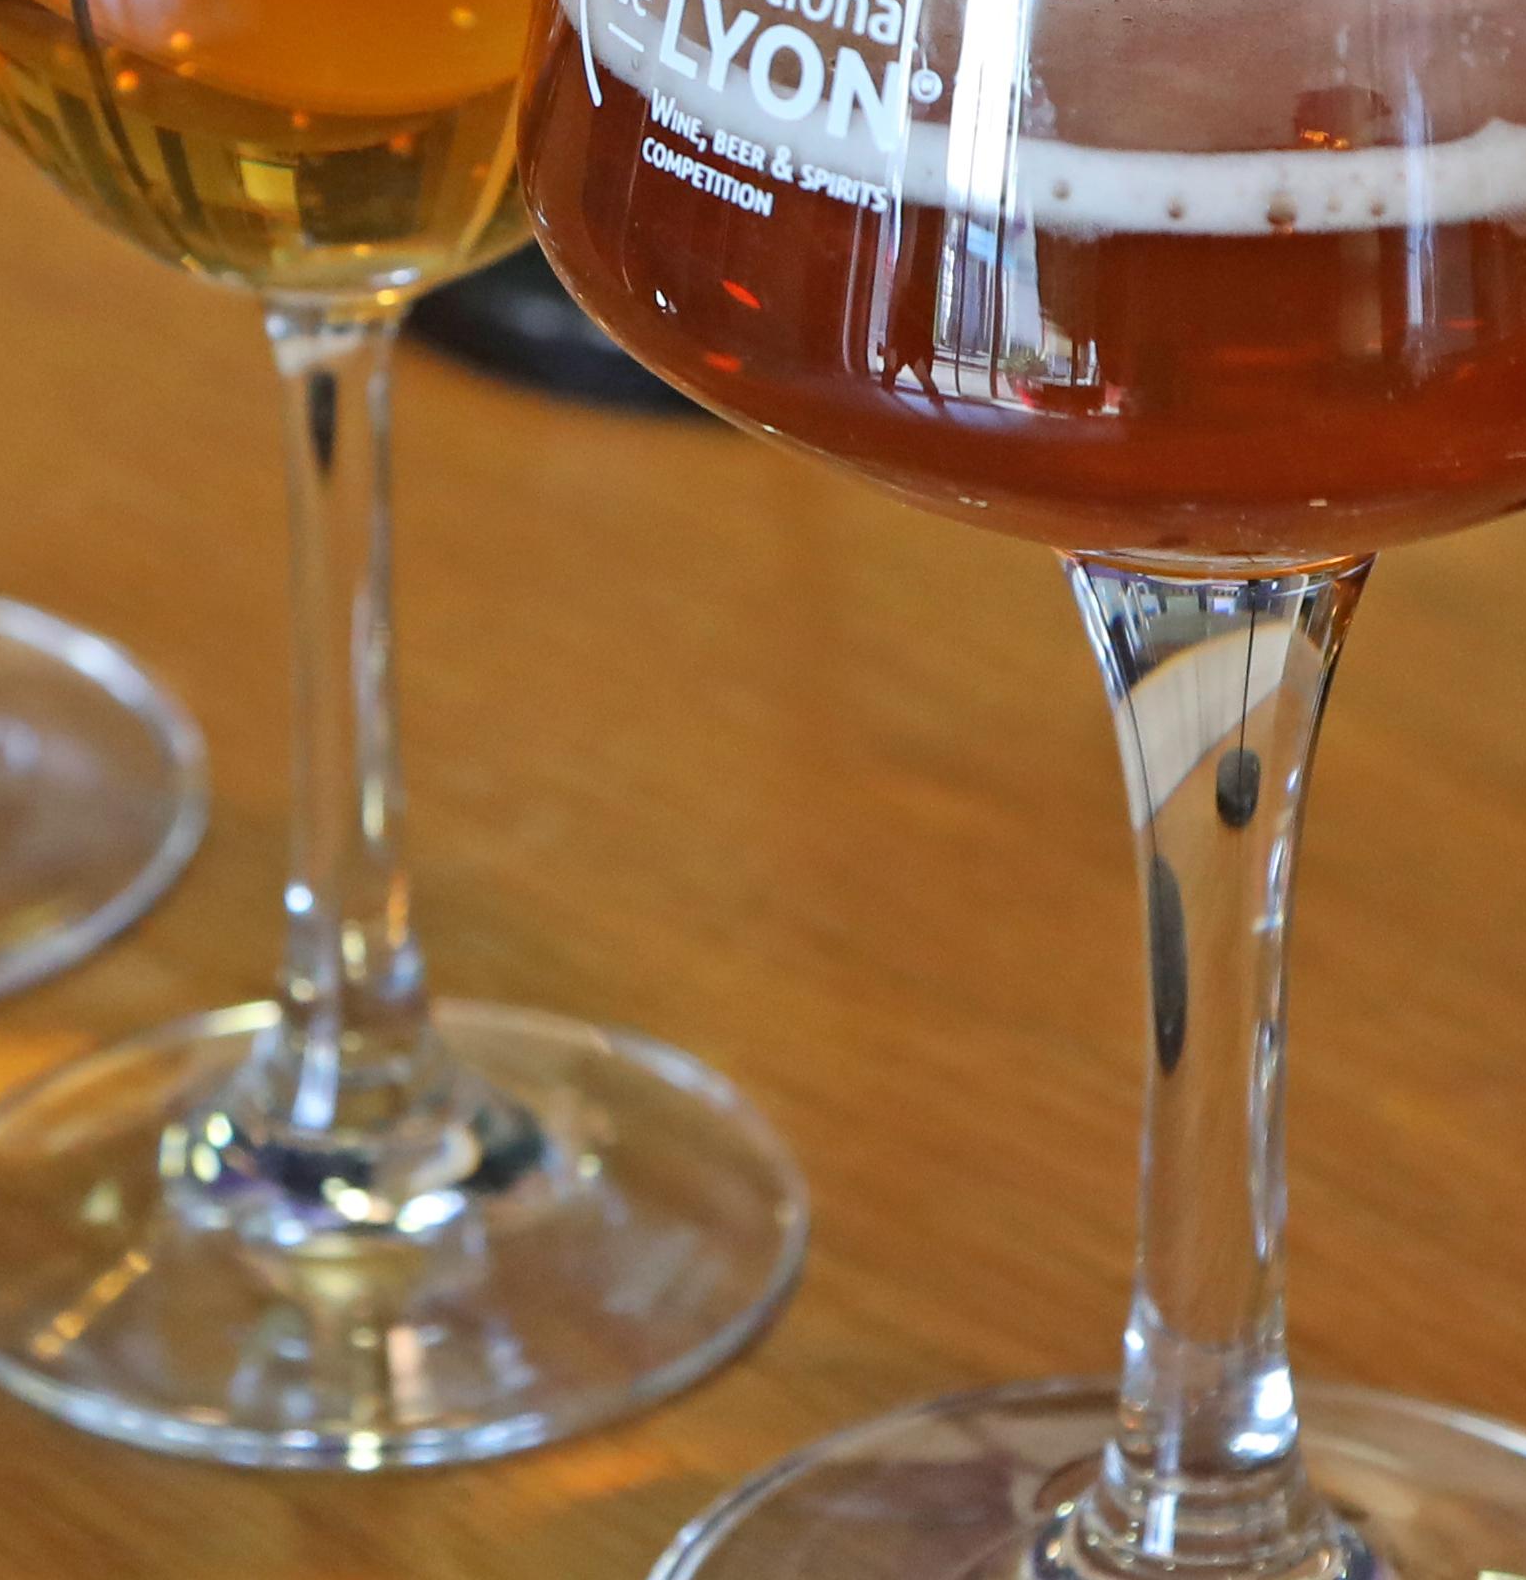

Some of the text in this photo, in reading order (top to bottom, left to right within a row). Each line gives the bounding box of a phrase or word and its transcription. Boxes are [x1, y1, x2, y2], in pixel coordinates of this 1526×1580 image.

[642, 137, 773, 217] COMPETITION
[712, 129, 765, 171] BEER
[771, 145, 794, 183] &
[798, 164, 889, 213] SPIRITS
